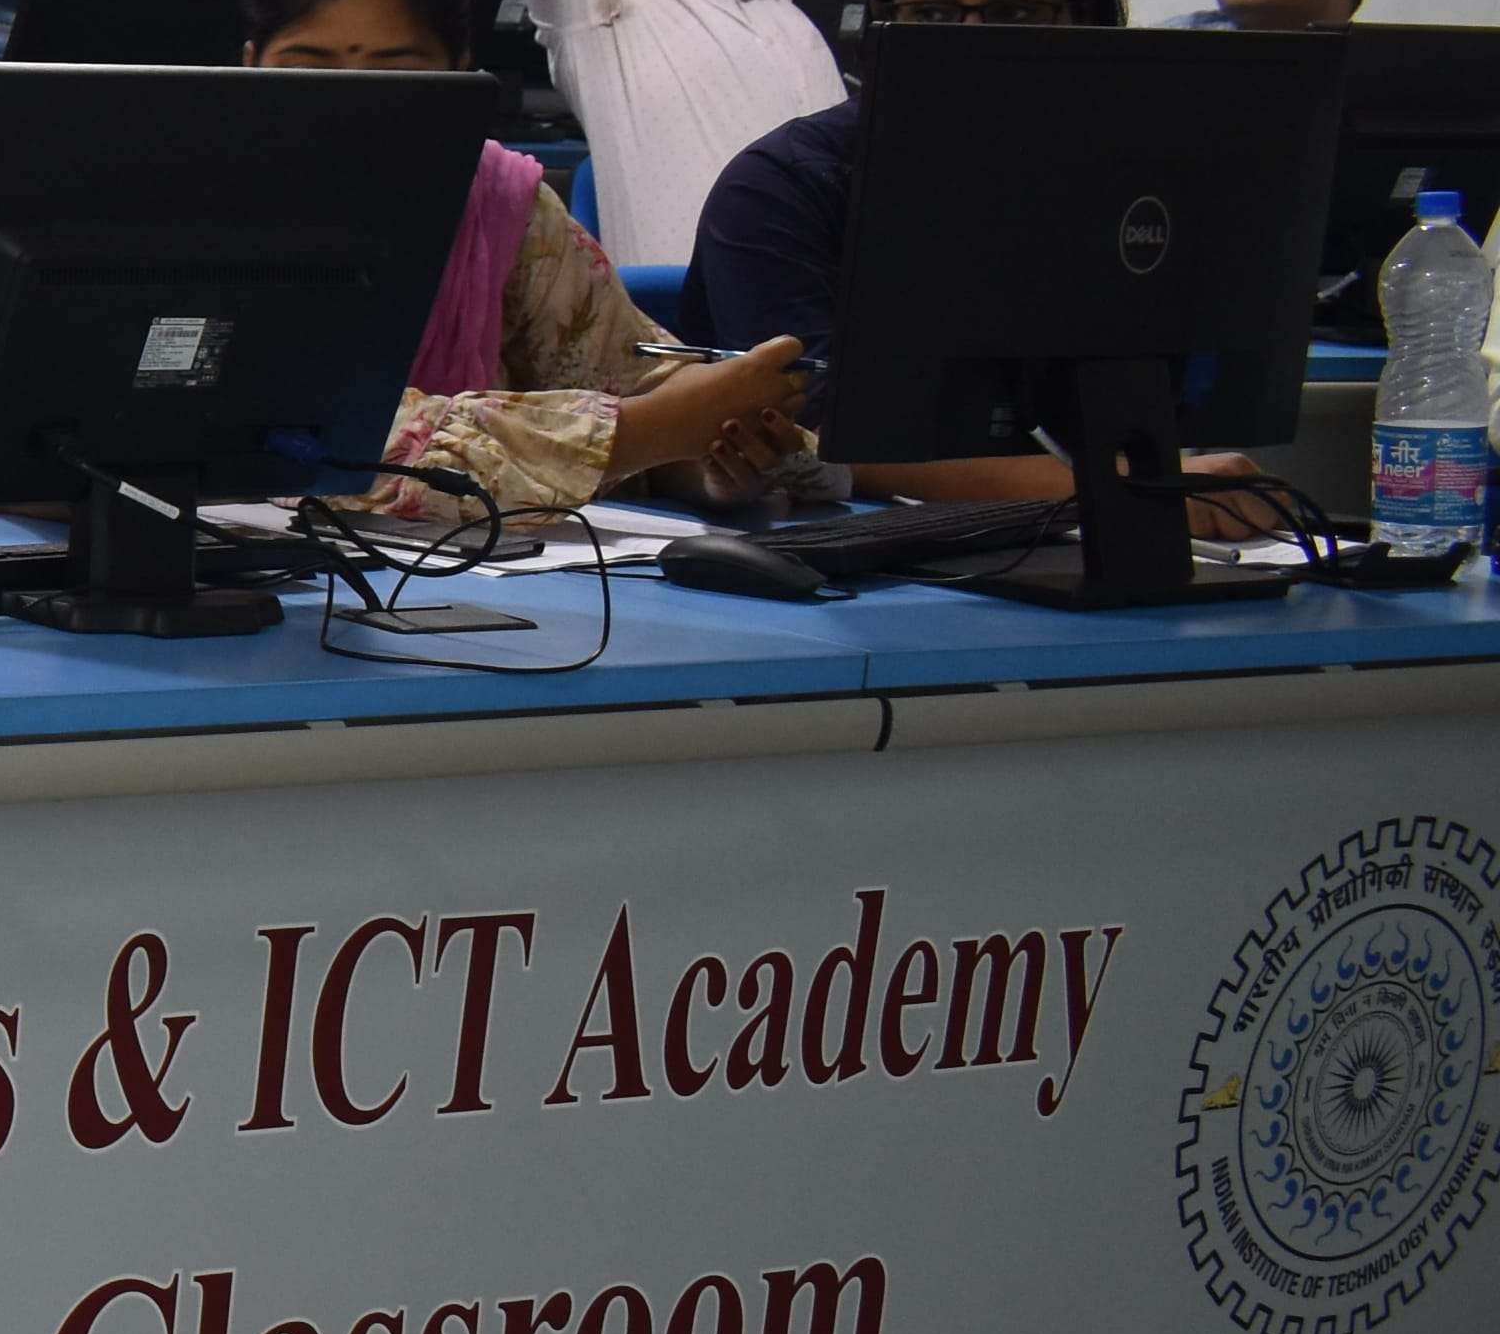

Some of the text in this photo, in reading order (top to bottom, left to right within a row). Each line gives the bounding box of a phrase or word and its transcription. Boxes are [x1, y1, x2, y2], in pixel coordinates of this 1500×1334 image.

[1385, 463, 1425, 478] neer
[1389, 439, 1420, 464] नीर
[65, 928, 197, 1150] &
[237, 912, 532, 1135] ICT
[544, 887, 1123, 1117] Academy
[1233, 926, 1301, 1033] भारतीय
[1424, 861, 1484, 924] संस्थान
[1211, 1120, 1491, 1299] INDIAN INSTITUTE OF TECHNOLOGY ROORKEE
